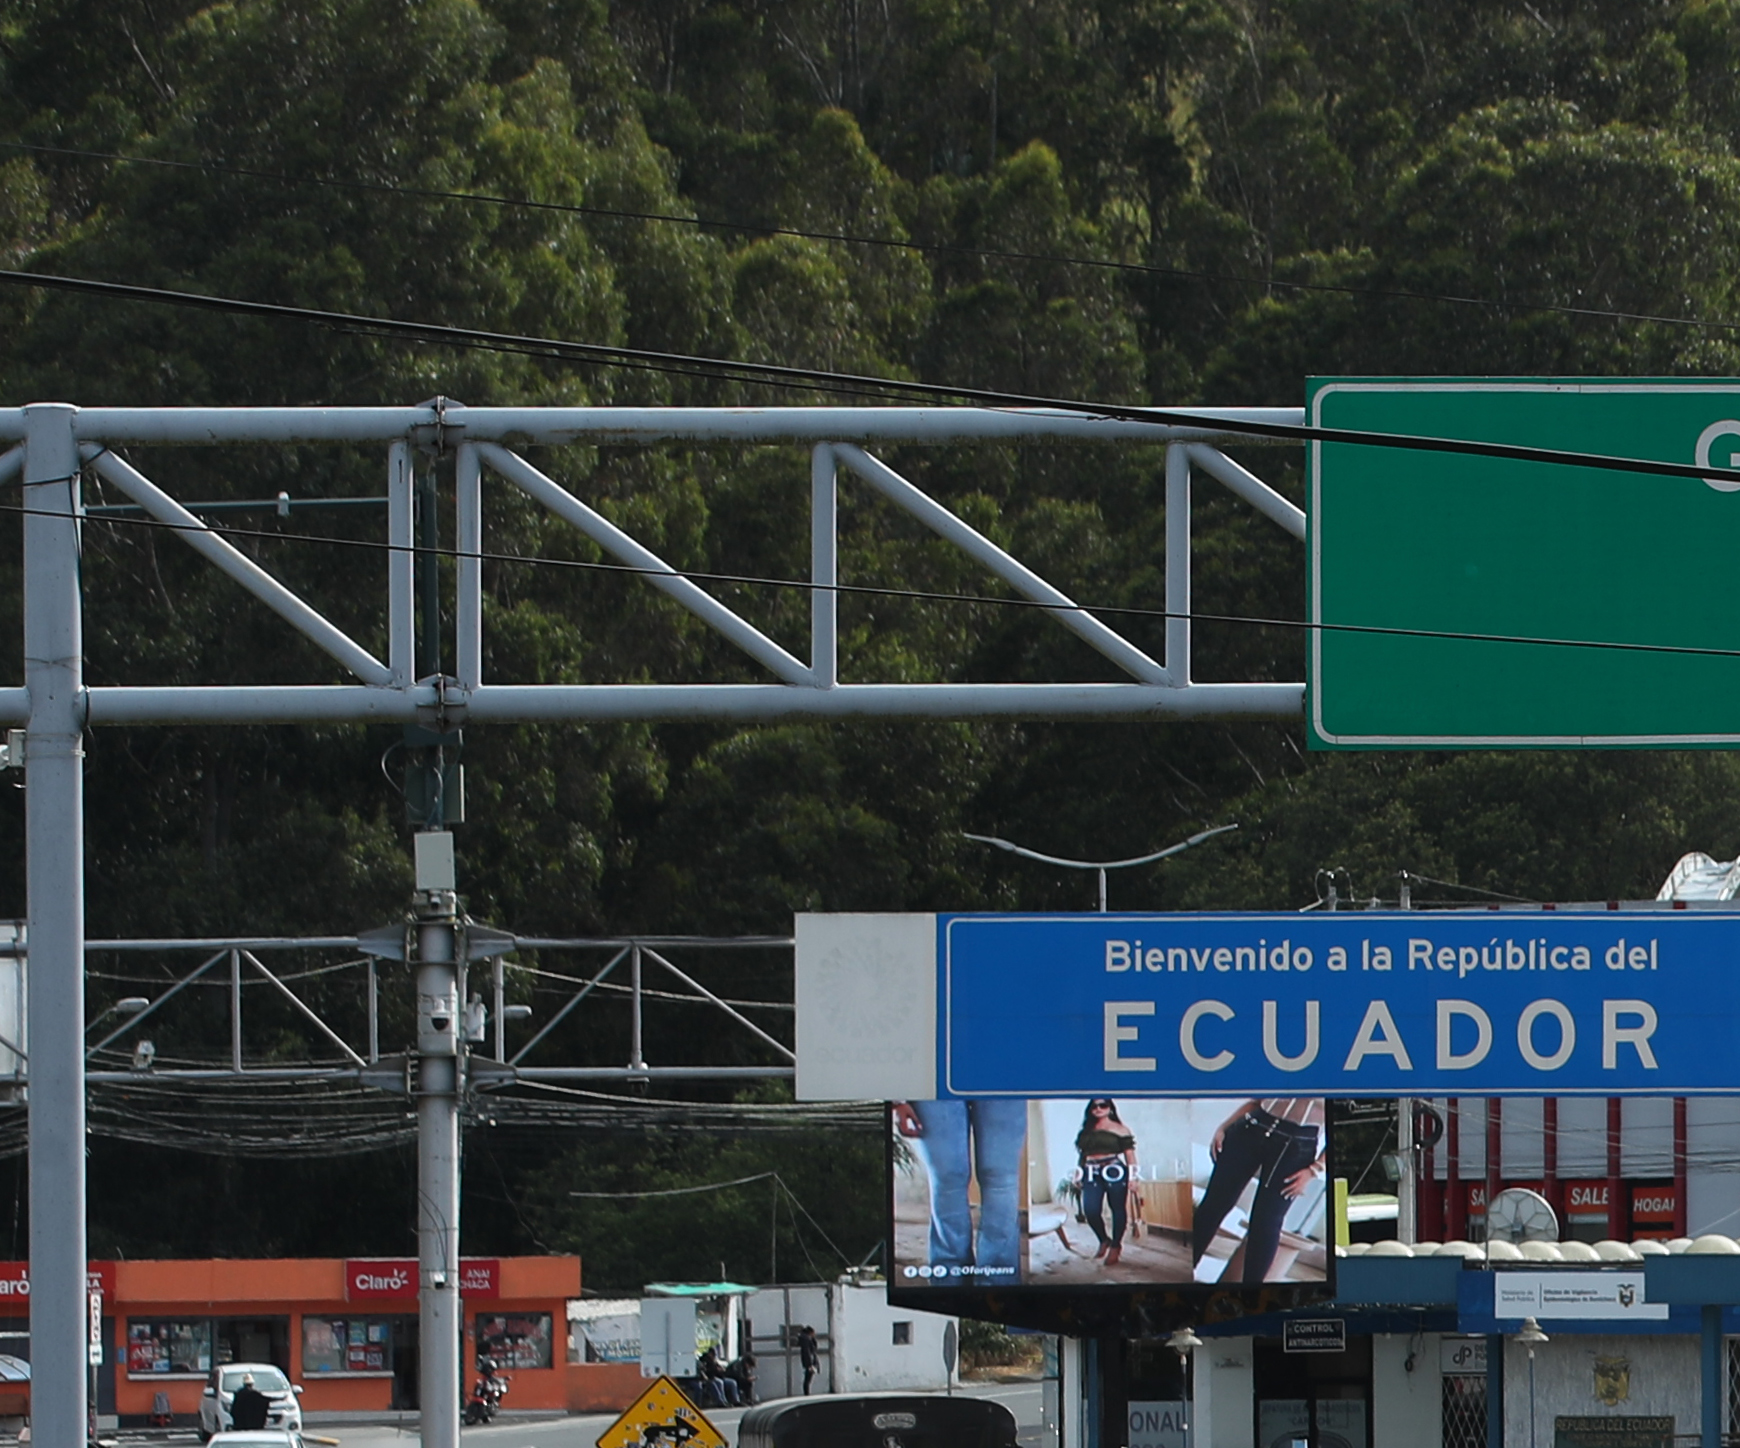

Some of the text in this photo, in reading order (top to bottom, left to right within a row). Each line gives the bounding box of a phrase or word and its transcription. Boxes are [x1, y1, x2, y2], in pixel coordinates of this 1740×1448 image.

[1105, 937, 1659, 978] Bienvenido a la República del
[1103, 999, 1659, 1072] ECUADOR
[356, 1269, 402, 1290] Claro
[1294, 1324, 1334, 1334] CONTROL
